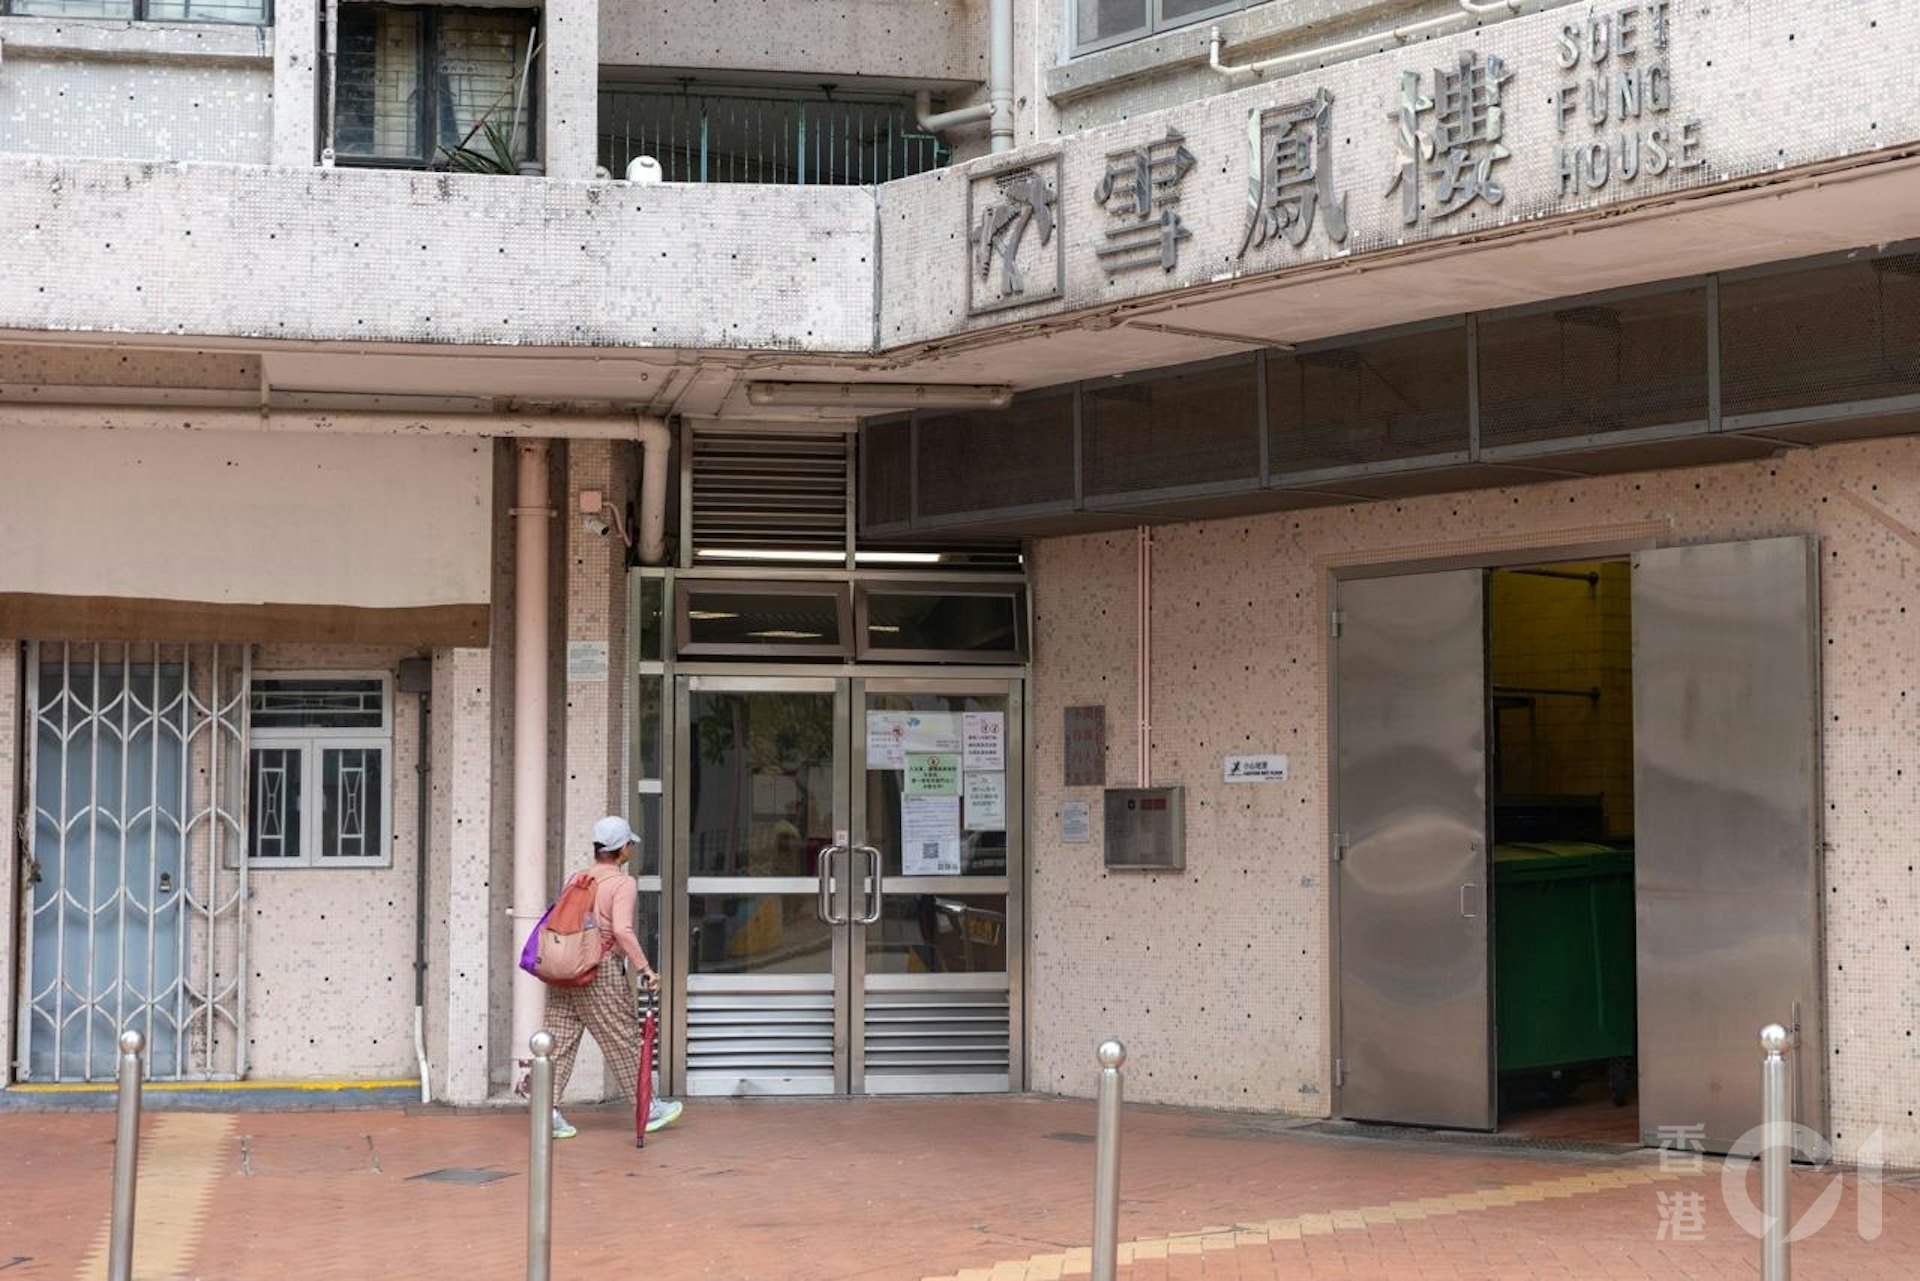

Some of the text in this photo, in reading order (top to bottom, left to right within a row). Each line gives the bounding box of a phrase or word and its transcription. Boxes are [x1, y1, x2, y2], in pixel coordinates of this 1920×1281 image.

[1557, 2, 1670, 69] SUET
[1556, 60, 1670, 133] FUNG
[1093, 49, 1516, 272] 雪鳳樓
[1553, 117, 1704, 197] HOUSE
